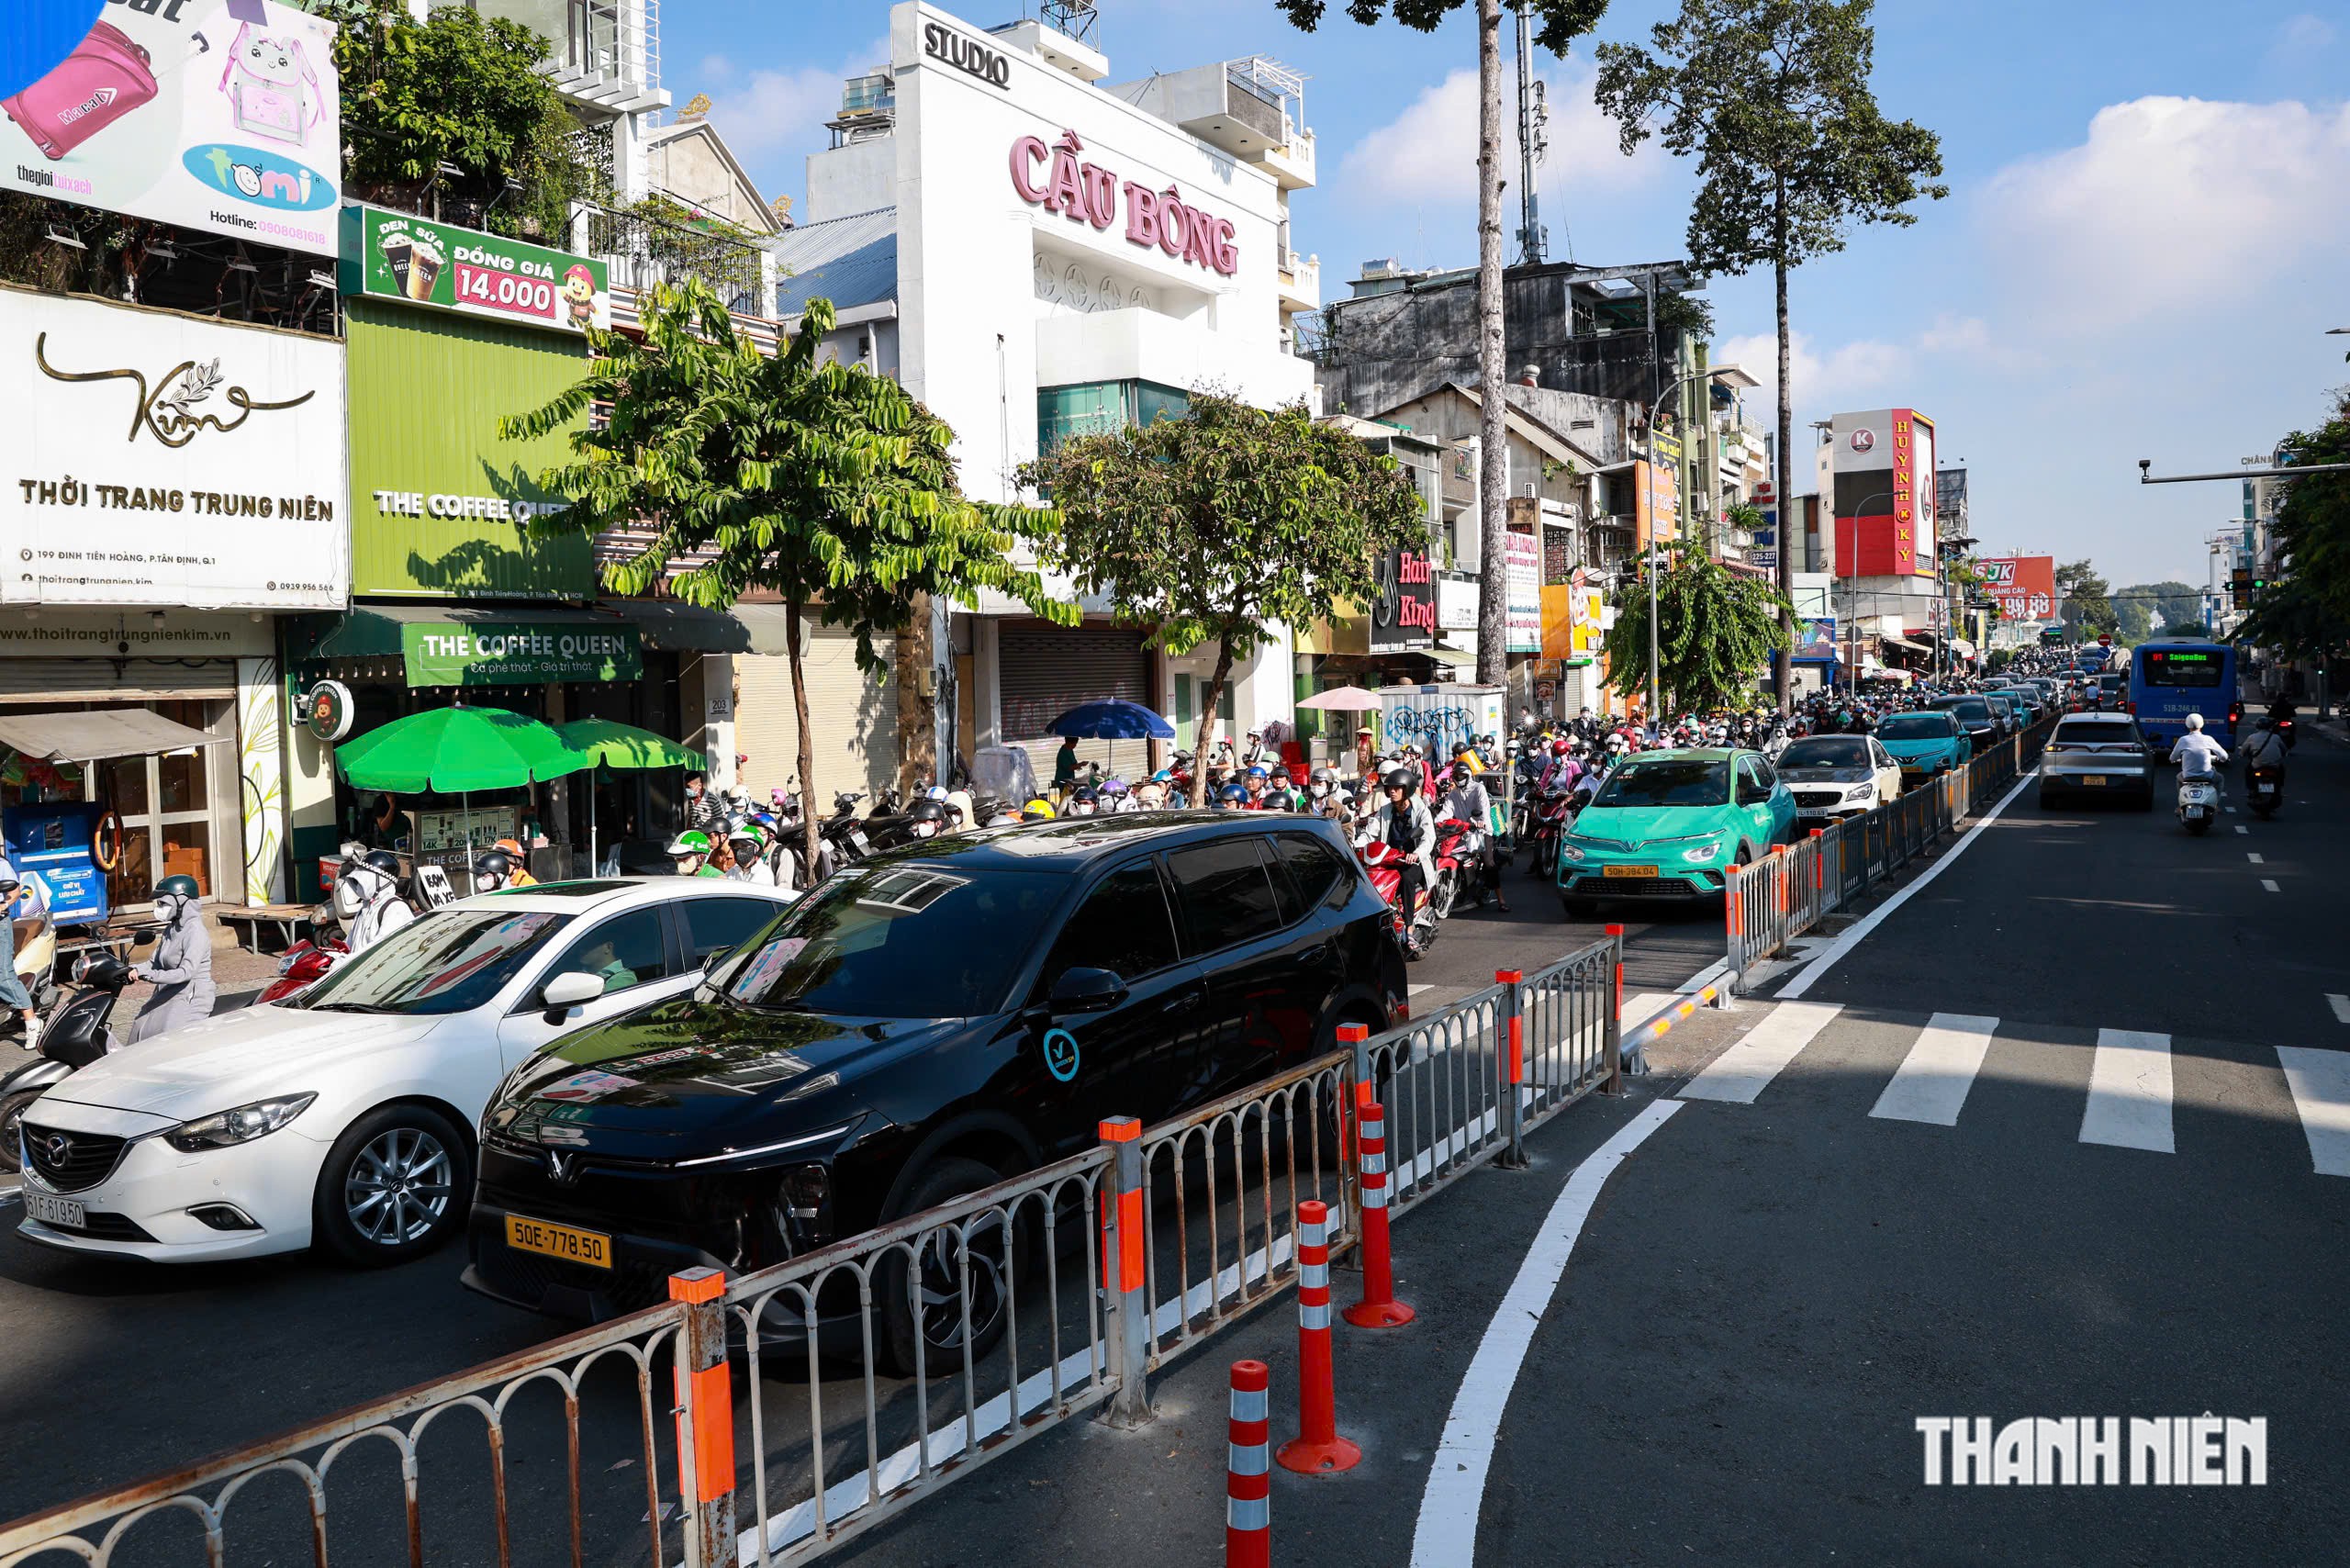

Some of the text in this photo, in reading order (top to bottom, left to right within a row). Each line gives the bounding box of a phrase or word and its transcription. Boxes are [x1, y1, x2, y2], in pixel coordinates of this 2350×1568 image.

[925, 23, 1010, 84] STUDIO
[58, 90, 108, 125] Macat
[1010, 129, 1238, 275] CẦU BÔNG
[210, 210, 325, 244] Hotline: 0908081618
[379, 219, 445, 251] ĐEN SỮA
[453, 245, 554, 280] ĐỒNG GIÁ
[461, 268, 551, 311] 14.000
[1856, 432, 1869, 445] K
[19, 475, 333, 521] THỜI TRANG TRUNG NIÊN
[374, 490, 424, 514] THE
[427, 494, 510, 520] COFFEE
[38, 551, 54, 559] 199
[58, 551, 82, 560] ĐINH
[86, 551, 106, 561] TIÊN
[109, 551, 147, 563] HOÀNG,
[150, 554, 173, 564] P.TÂN
[1399, 552, 1432, 585] Hair
[1753, 553, 1775, 561] 225-227
[302, 583, 317, 591] 956
[1988, 587, 2010, 595] QUẢNG
[2012, 587, 2026, 595] CÁO
[1399, 595, 1435, 633] King
[423, 635, 625, 660] THE COFFEE QUEEN
[488, 661, 508, 673] phê
[510, 661, 532, 672] thật
[541, 661, 558, 672] Giá
[572, 660, 592, 672] thật
[712, 700, 726, 710] 203
[423, 840, 438, 849] 14K
[427, 852, 483, 865] THE COFEE
